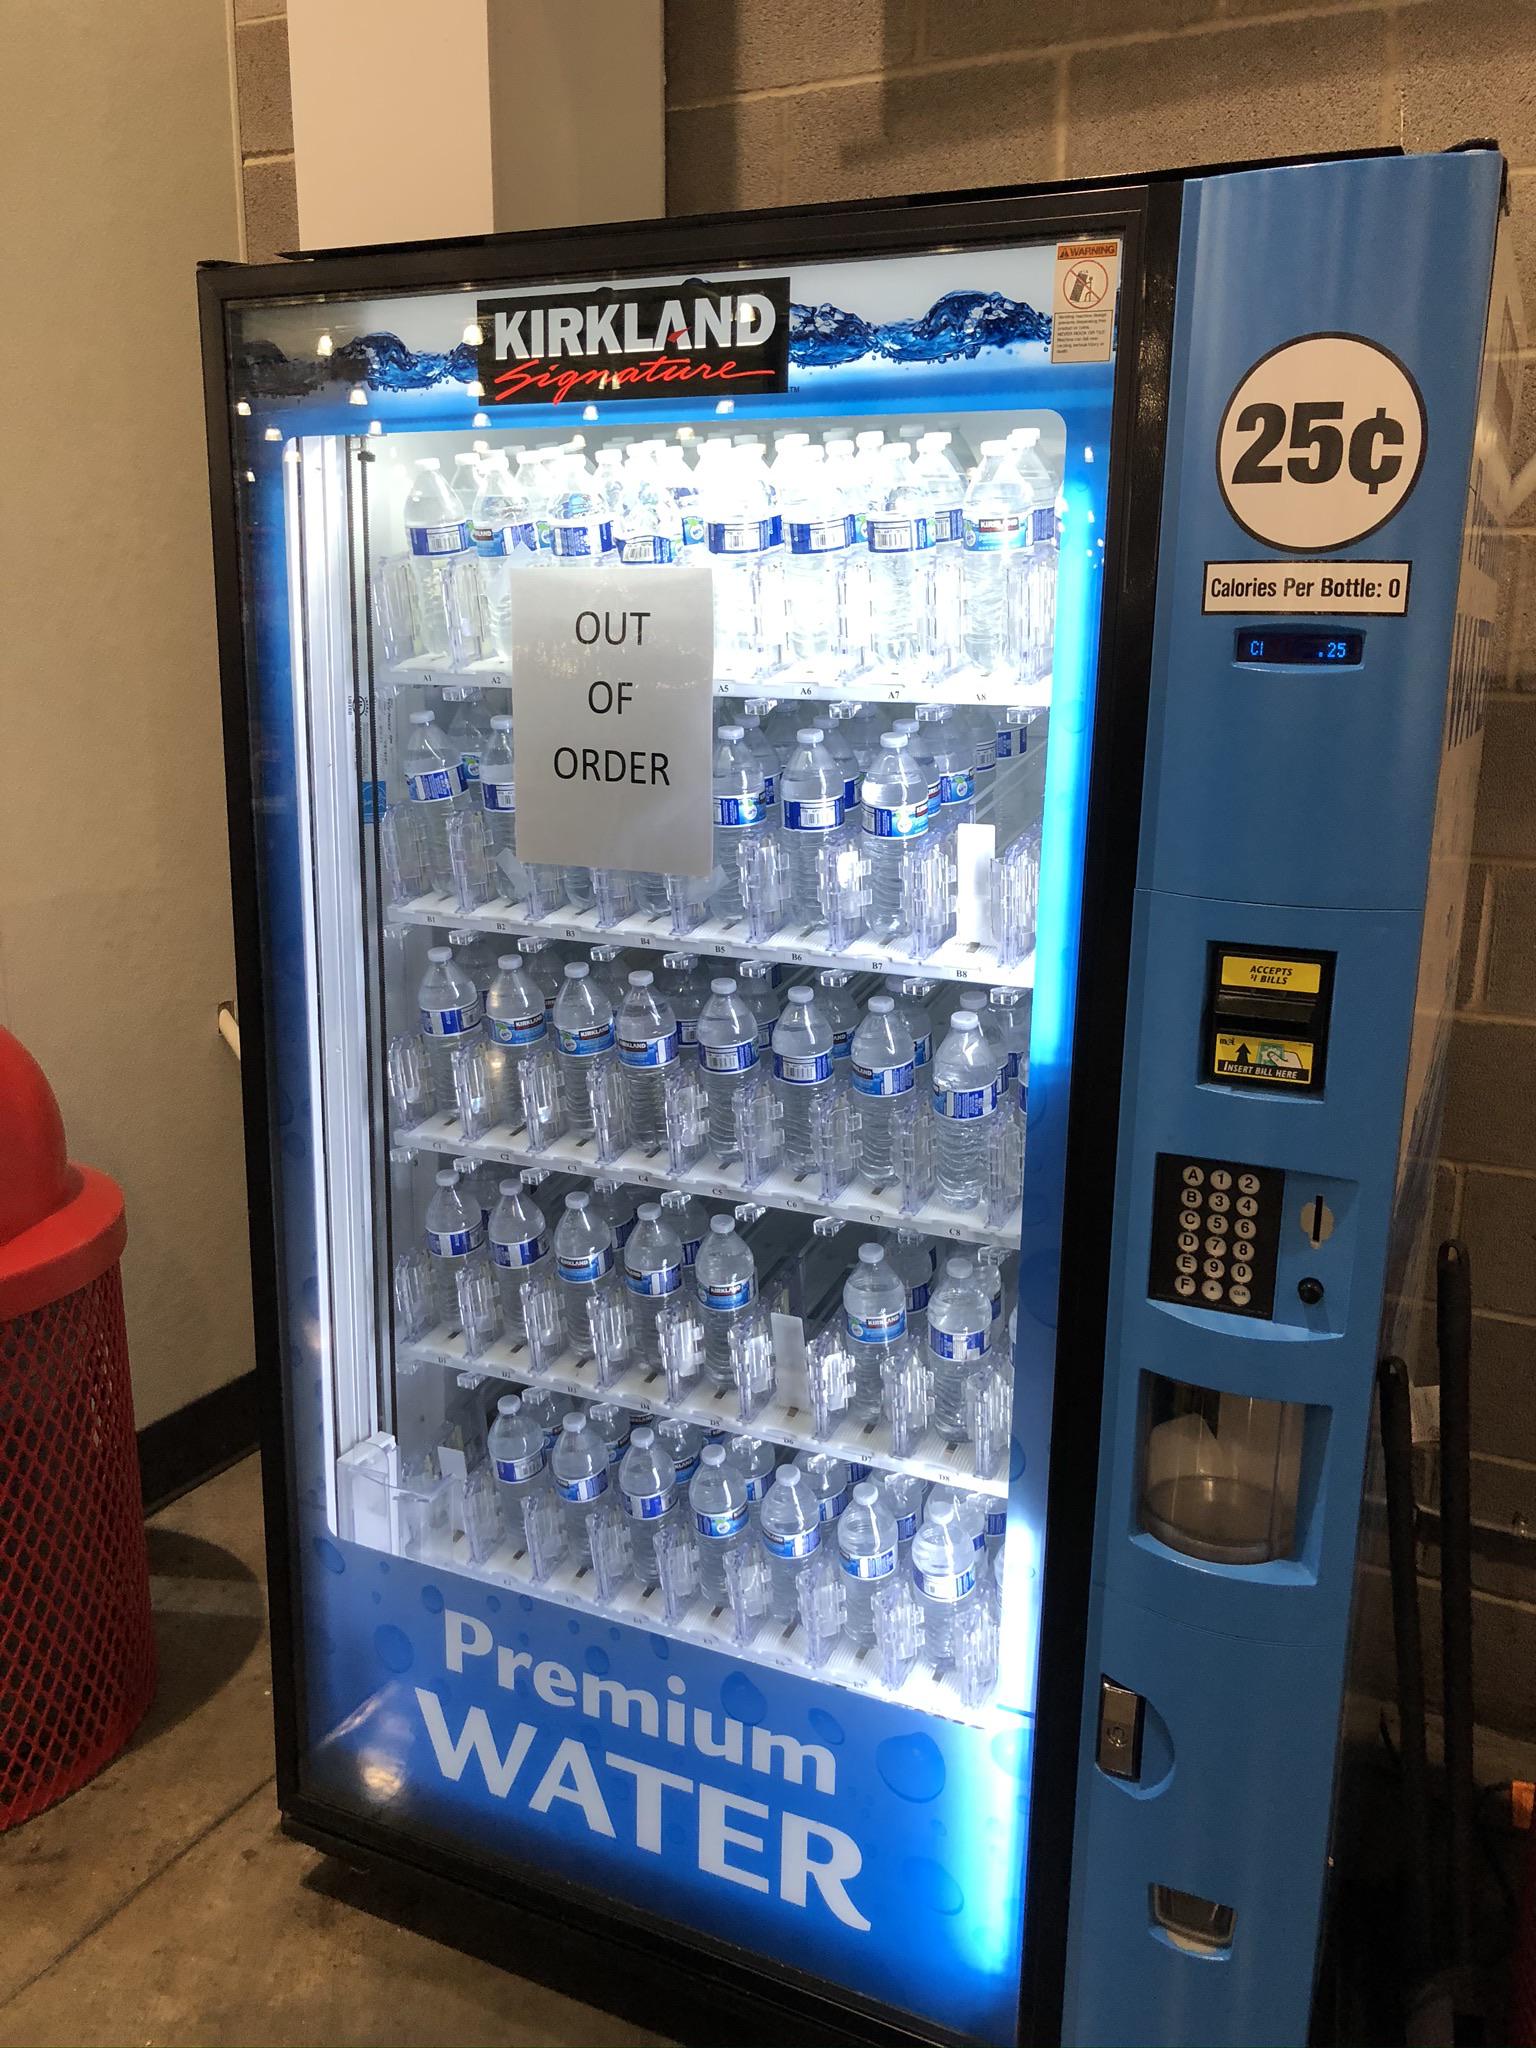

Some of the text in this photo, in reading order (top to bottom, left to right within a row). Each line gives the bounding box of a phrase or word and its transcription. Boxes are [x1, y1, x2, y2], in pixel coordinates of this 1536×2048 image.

[1072, 245, 1115, 256] WARNING
[495, 294, 776, 360] KIRKLAND
[494, 355, 775, 406] Signature
[1231, 401, 1404, 495] 25¢
[1211, 577, 1400, 598] Calories Per Bottle: 0
[575, 611, 651, 646] OUT
[588, 680, 633, 715] OF
[800, 687, 812, 696] A6
[888, 690, 900, 700] A7
[553, 746, 671, 786] ORDER
[565, 929, 576, 938] B3
[715, 945, 726, 954] B5
[791, 952, 802, 961] B6
[872, 962, 883, 970] B7
[956, 969, 968, 978] B8
[1250, 965, 1294, 977] ACCEPTS
[1260, 975, 1288, 985] BILLS
[1223, 1061, 1299, 1080] INSERT BILL HERE
[1188, 1168, 1254, 1189] A 1 2
[1186, 1191, 1251, 1212] B 3 4
[1184, 1213, 1250, 1234] C 5 6
[1183, 1235, 1248, 1256] D 7 8
[1182, 1257, 1246, 1278] E 9 0
[1180, 1278, 1190, 1290] F
[444, 1608, 836, 1796] Premium
[414, 1686, 872, 1932] WATER
